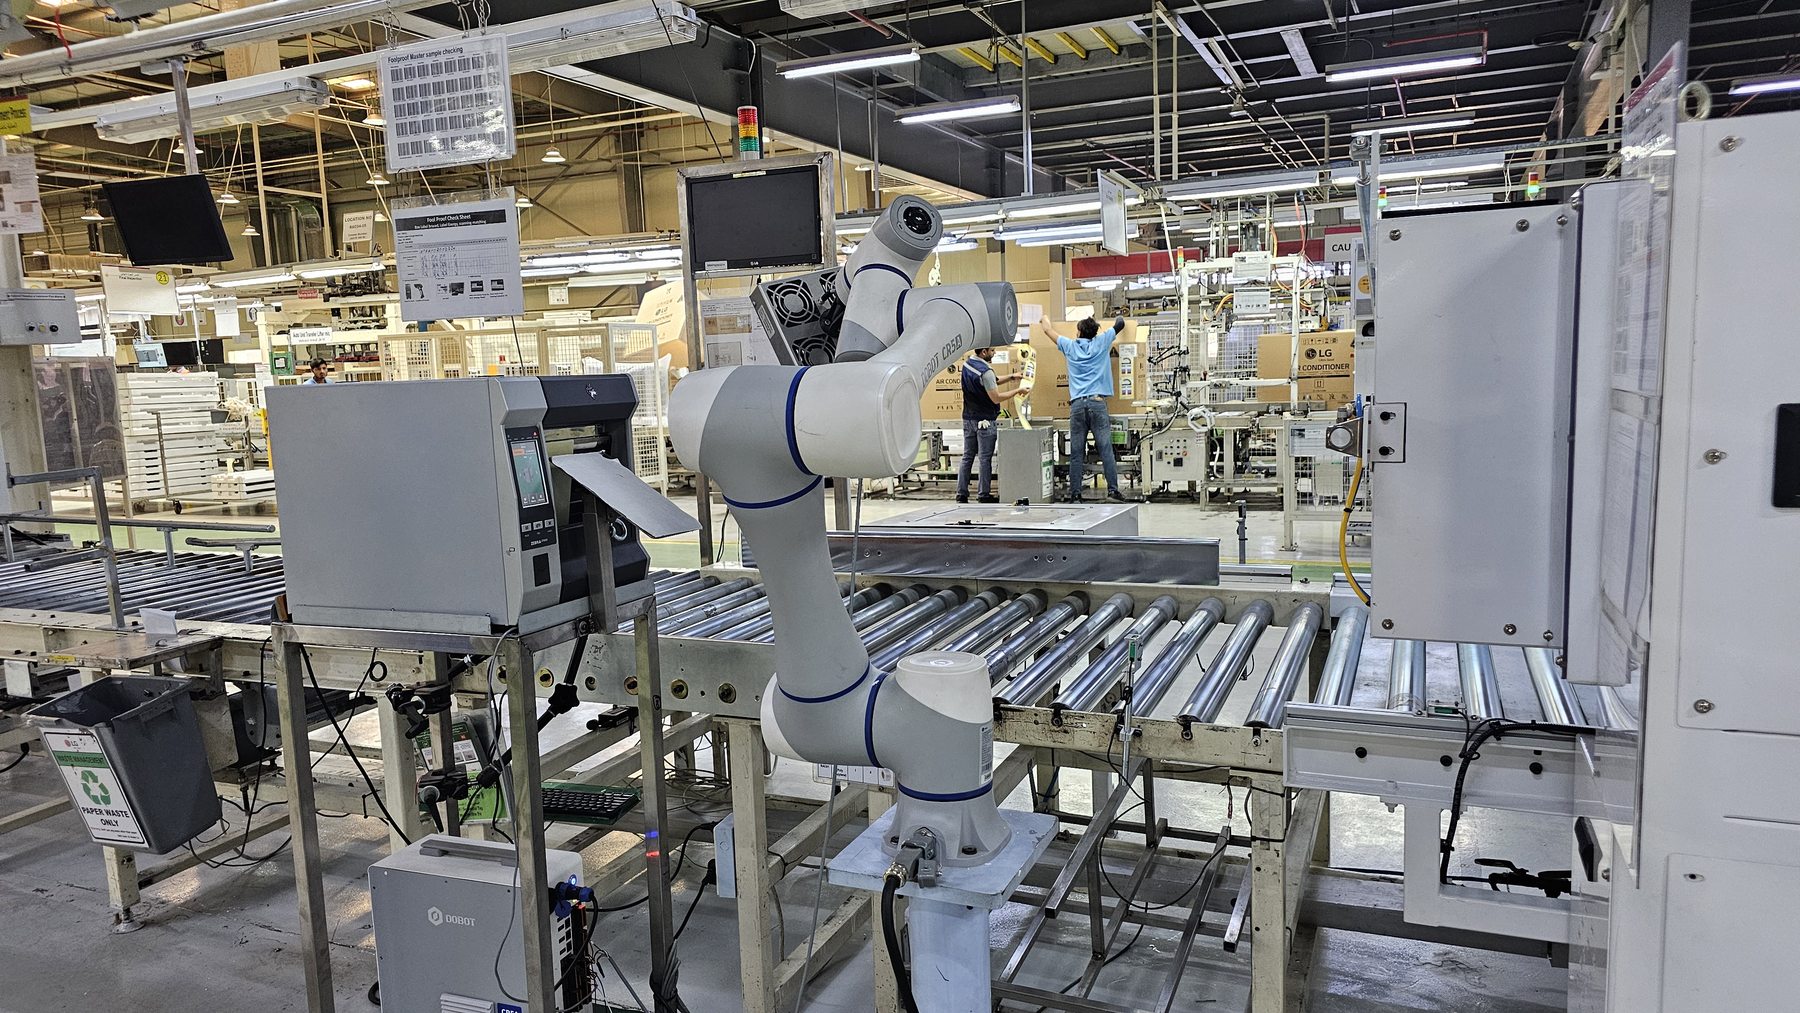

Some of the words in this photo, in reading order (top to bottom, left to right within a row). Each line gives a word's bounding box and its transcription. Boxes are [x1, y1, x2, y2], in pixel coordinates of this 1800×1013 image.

[388, 54, 410, 63] Foolproof
[442, 46, 464, 54] checking
[1319, 349, 1332, 357] LG
[82, 807, 103, 815] PAPER
[104, 809, 130, 818] WASTE
[446, 914, 476, 926] DOBOT
